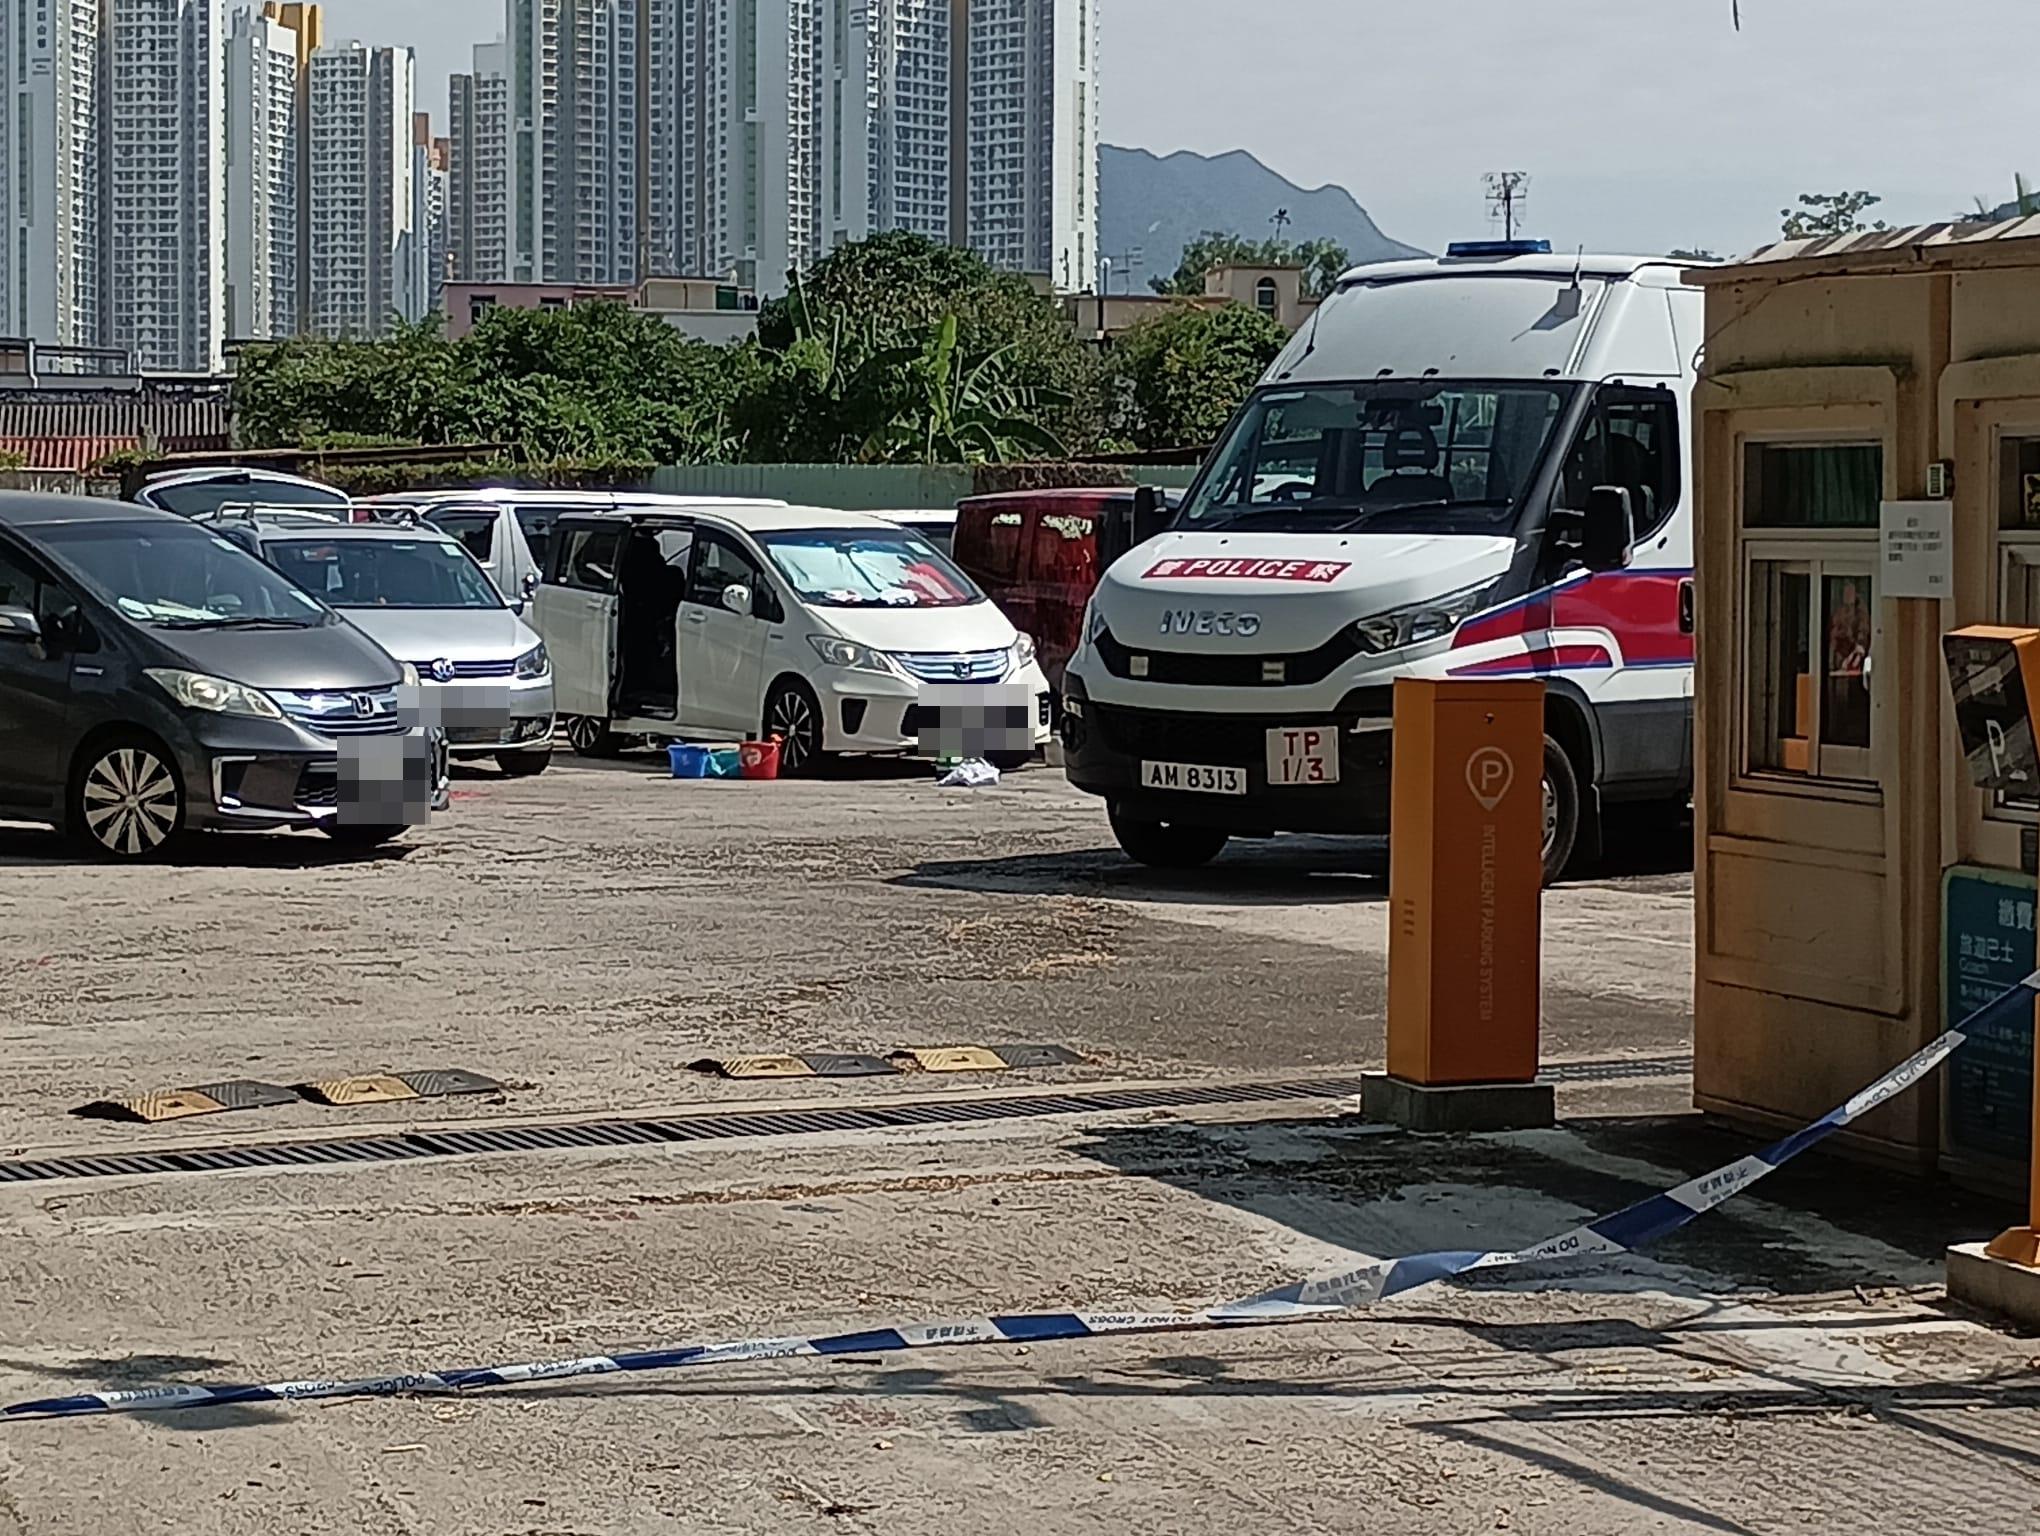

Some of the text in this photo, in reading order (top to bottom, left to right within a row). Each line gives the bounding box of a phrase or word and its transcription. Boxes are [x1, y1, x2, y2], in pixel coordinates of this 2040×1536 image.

[1184, 560, 1304, 577] POLICE
[1160, 609, 1261, 636] IVECO
[1283, 731, 1320, 756] TP
[1150, 765, 1238, 791] AM 8313
[1282, 758, 1323, 782] 1/3
[1480, 908, 1495, 966] PARKING
[1479, 967, 1494, 1021] SYSTEM
